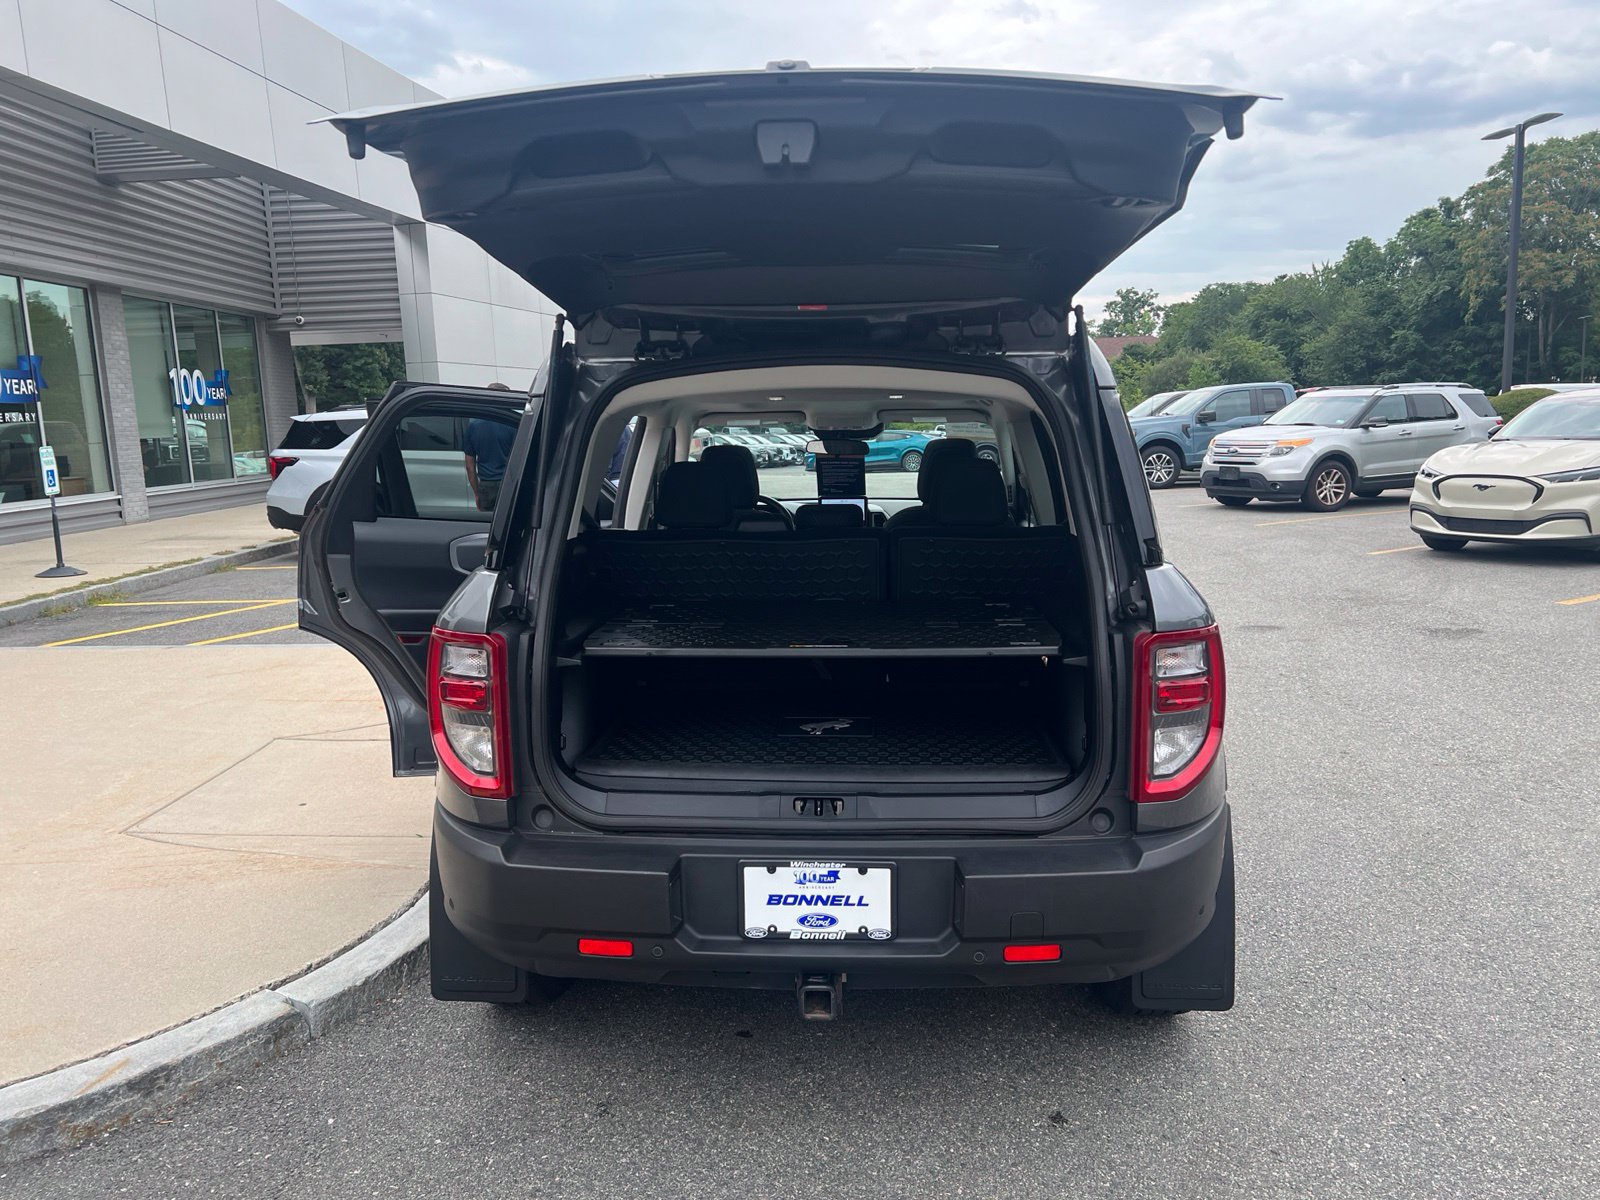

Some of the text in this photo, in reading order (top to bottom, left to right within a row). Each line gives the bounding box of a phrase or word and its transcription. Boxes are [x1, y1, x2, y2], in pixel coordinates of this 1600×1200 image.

[3, 378, 38, 395] YEAR
[168, 367, 207, 406] 100
[185, 412, 227, 421] ANNIVERSARY
[789, 861, 847, 869] Winchester
[793, 869, 820, 884] 100
[766, 893, 870, 907] BONNELL
[803, 914, 832, 928] Ford
[789, 928, 847, 941] Bonnell
